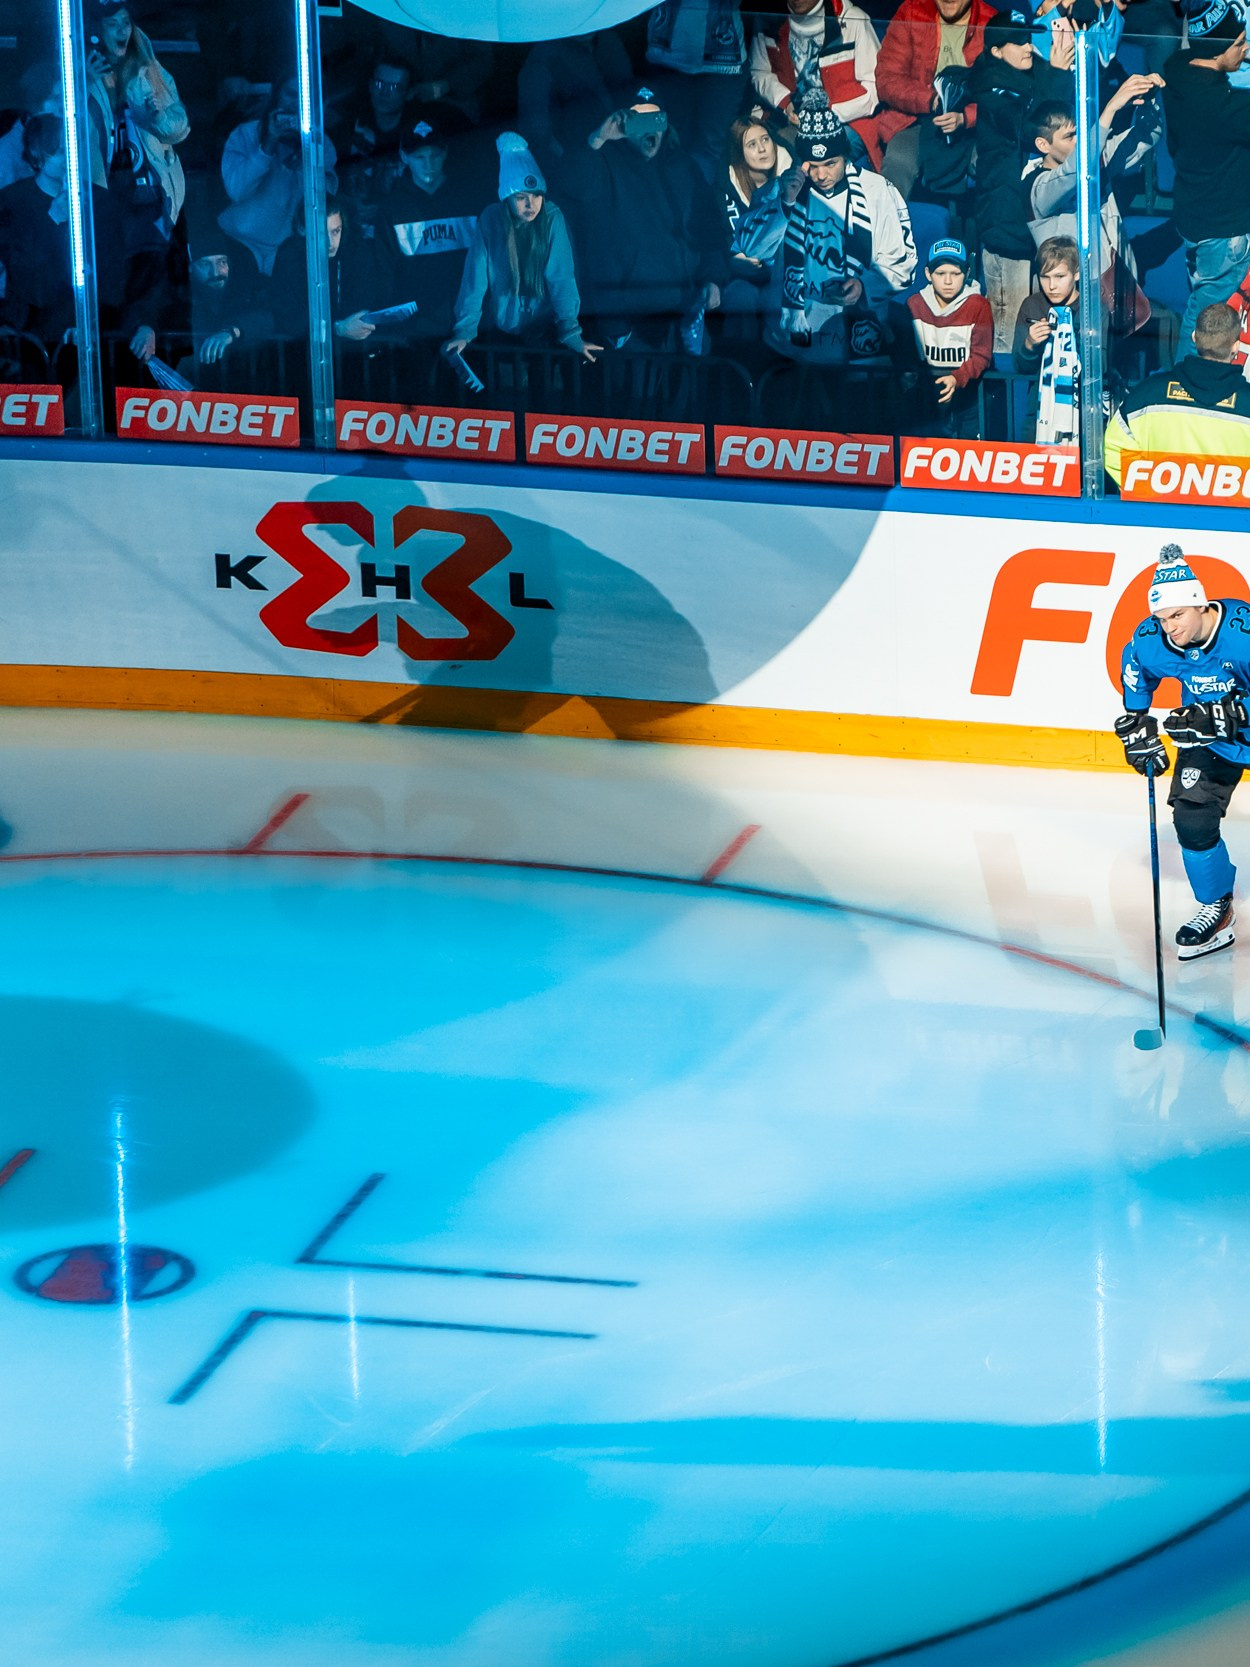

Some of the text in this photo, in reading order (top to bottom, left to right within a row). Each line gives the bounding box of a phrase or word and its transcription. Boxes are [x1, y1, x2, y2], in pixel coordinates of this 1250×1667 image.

[422, 223, 457, 246] PUMA
[120, 397, 295, 438] FONBET
[339, 410, 511, 452] FONBET
[529, 423, 700, 465] FONBET
[718, 435, 890, 476] FONBET
[903, 446, 1077, 488] FONBET
